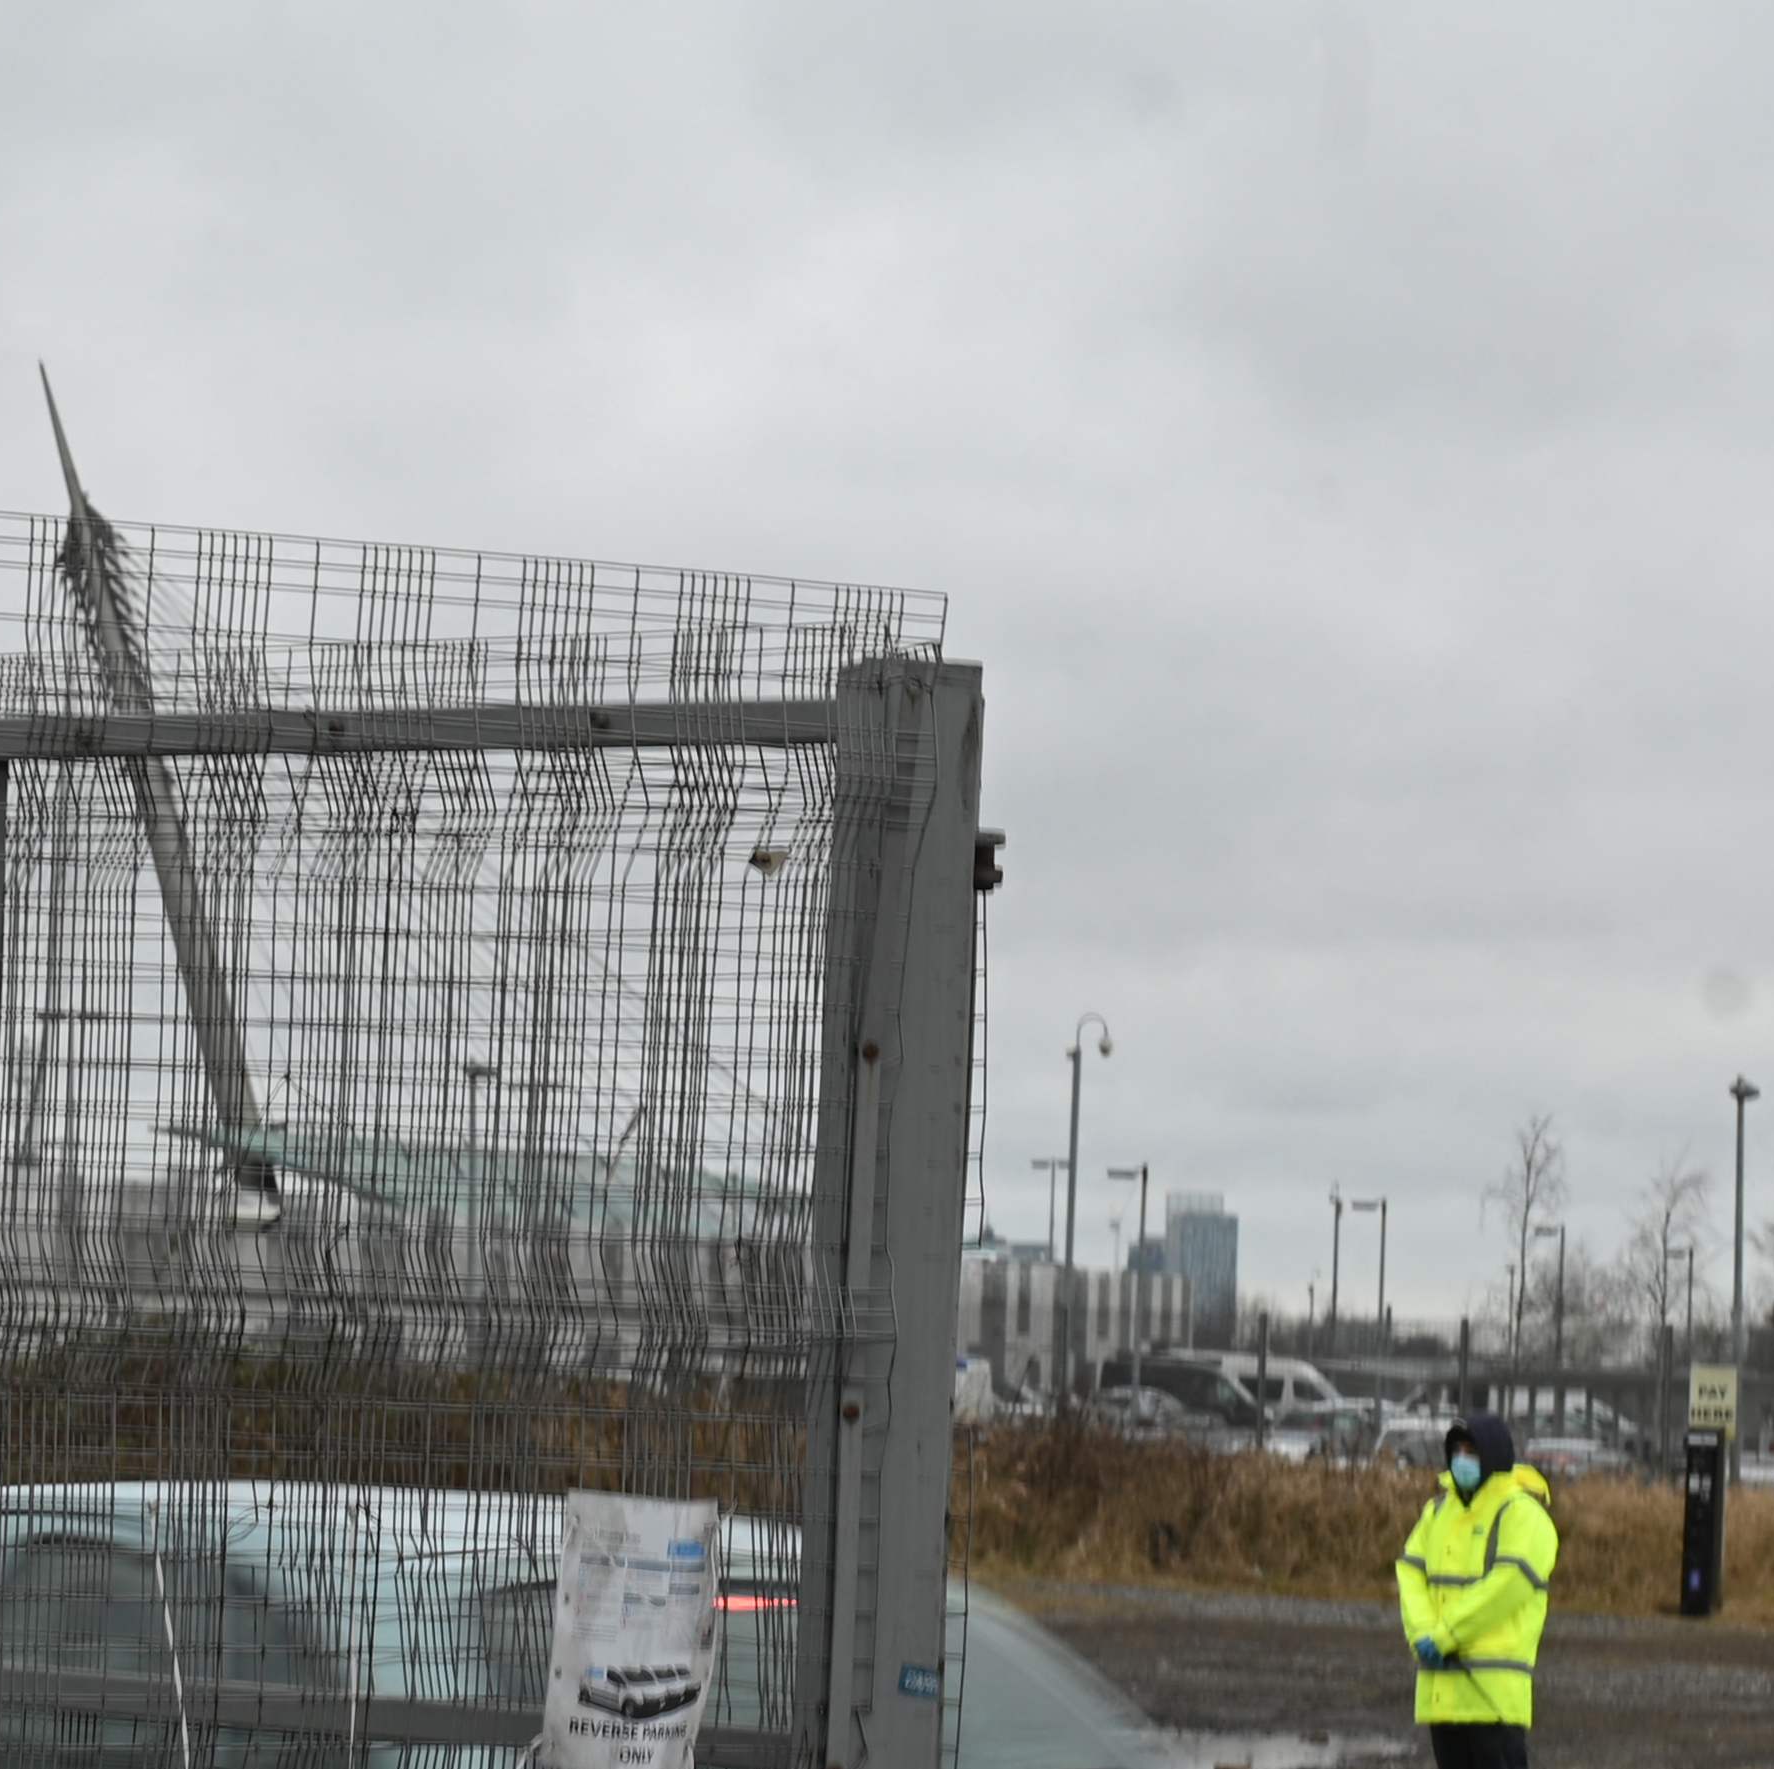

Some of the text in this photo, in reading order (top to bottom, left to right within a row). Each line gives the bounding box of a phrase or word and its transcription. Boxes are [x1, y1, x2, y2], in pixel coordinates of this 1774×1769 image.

[1698, 1383, 1729, 1401] PAY
[1690, 1406, 1734, 1422] HERE
[568, 1717, 639, 1740] REVERSE
[619, 1745, 654, 1764] ONLY
